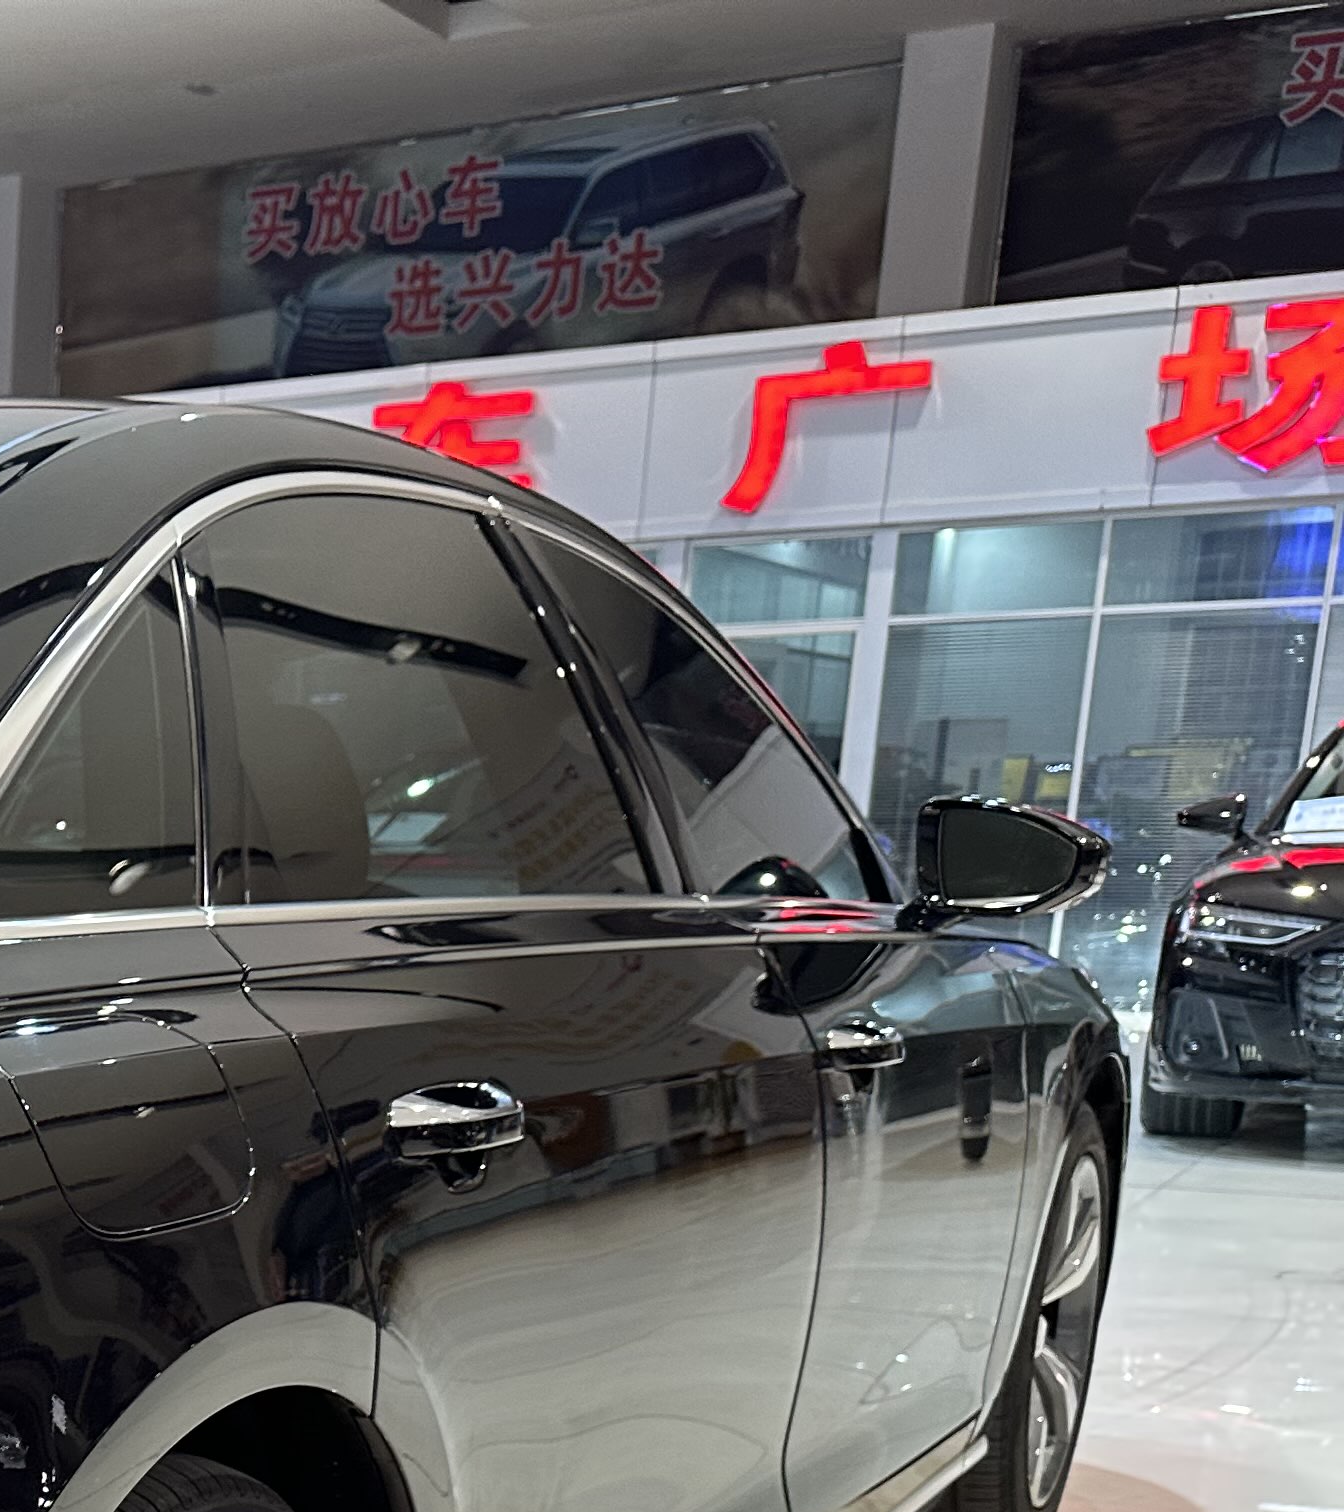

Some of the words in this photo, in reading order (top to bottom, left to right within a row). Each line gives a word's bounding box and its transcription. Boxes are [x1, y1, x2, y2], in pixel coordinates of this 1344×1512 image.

[244, 155, 504, 265] 买放心车
[386, 227, 665, 338] 选兴力达
